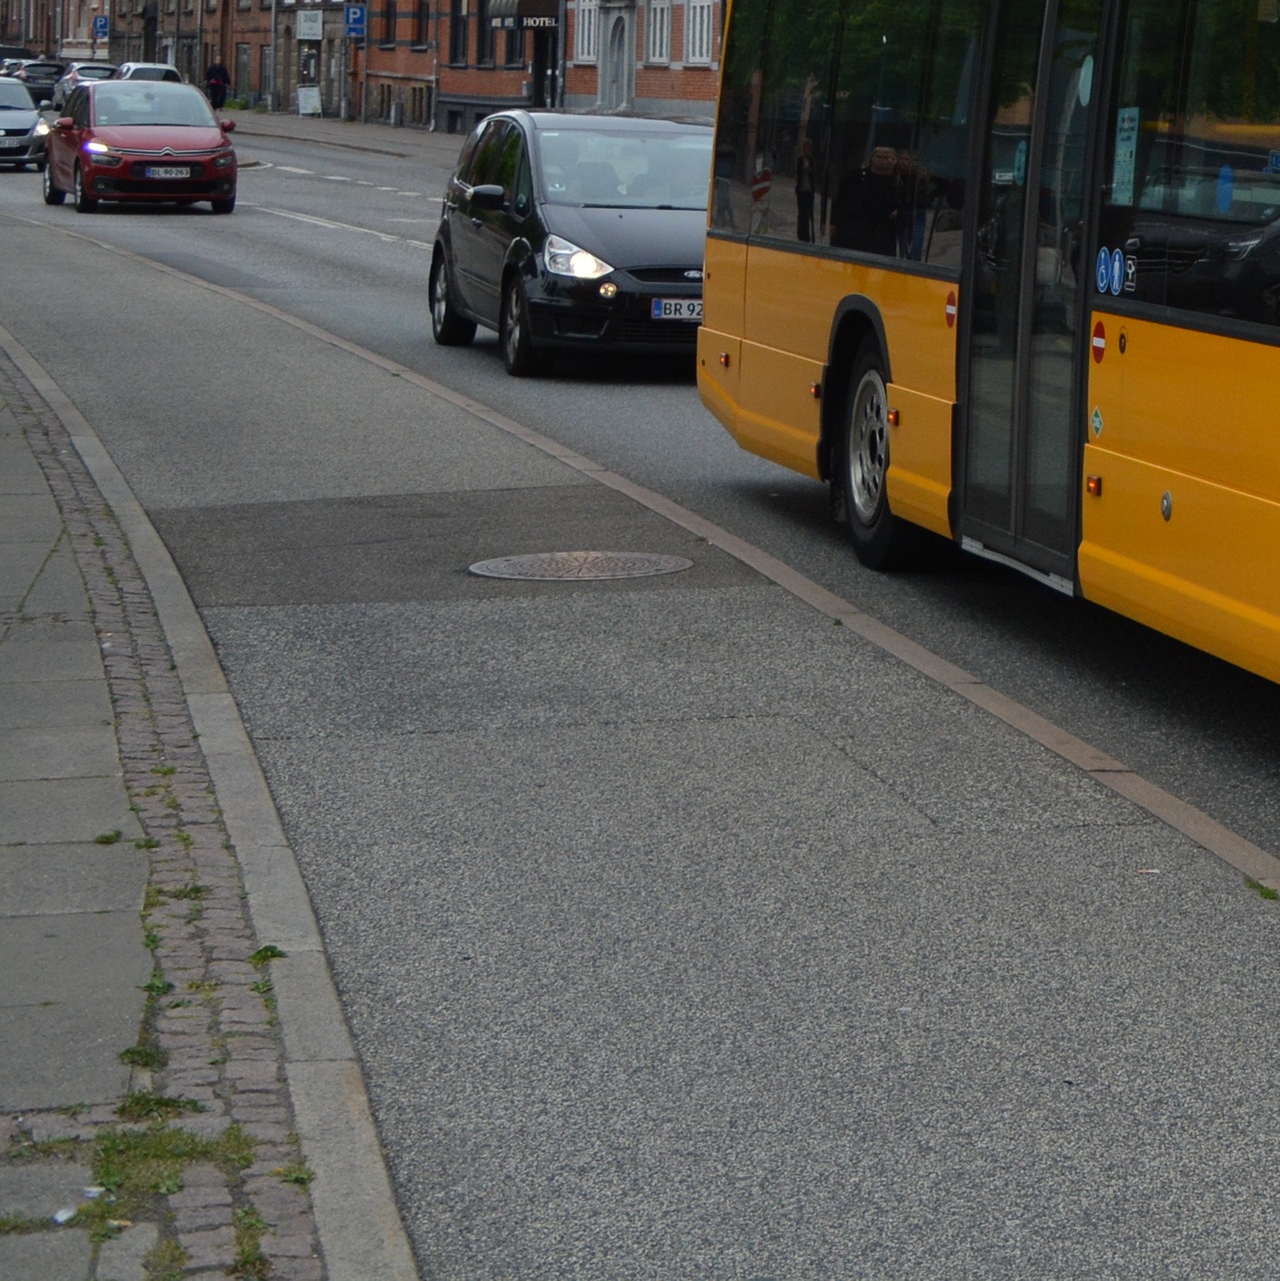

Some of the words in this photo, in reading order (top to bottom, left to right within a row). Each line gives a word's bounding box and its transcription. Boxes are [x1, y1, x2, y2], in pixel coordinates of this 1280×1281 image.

[349, 7, 361, 23] P
[96, 17, 106, 29] P
[523, 17, 558, 27] HOTEL
[663, 302, 683, 316] BR
